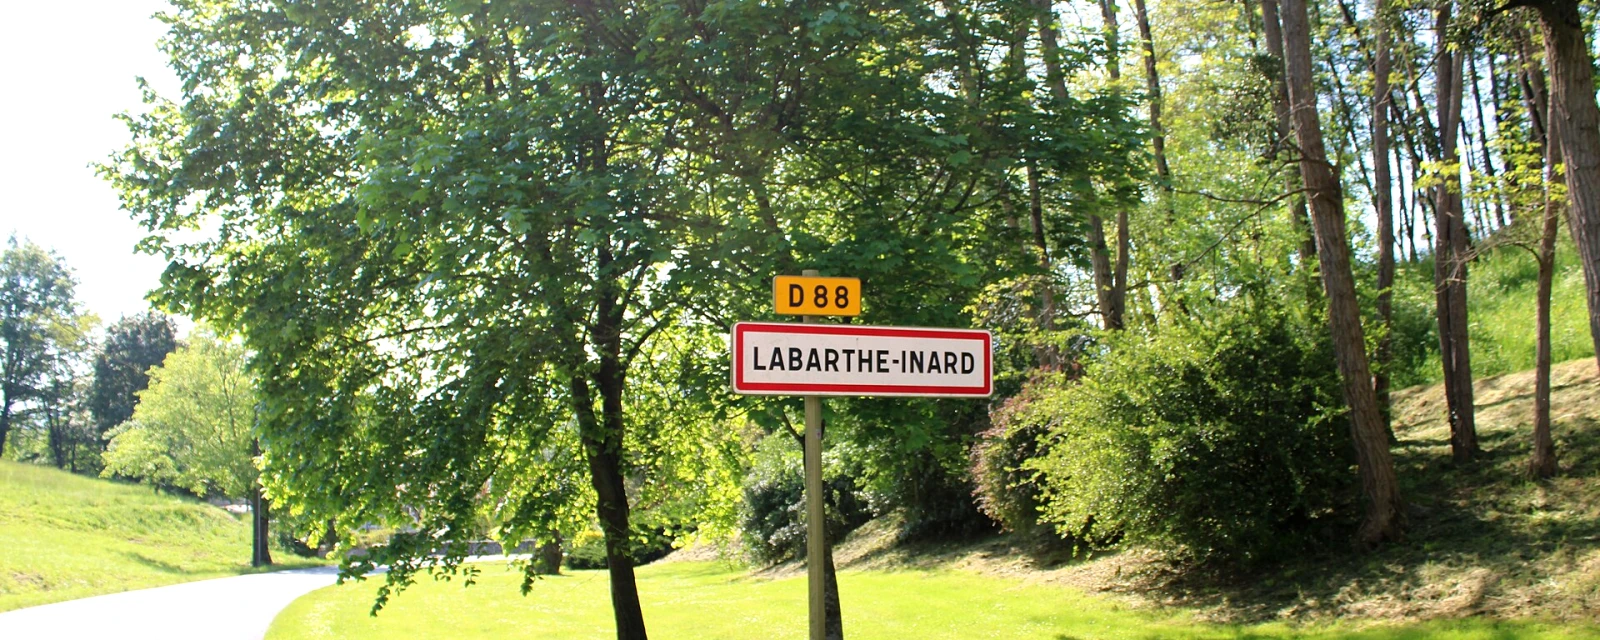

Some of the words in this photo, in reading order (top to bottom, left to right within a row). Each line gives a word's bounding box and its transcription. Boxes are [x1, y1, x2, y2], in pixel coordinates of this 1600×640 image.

[789, 284, 804, 308] D
[813, 285, 849, 309] 88
[753, 346, 975, 375] LABARTHE-INARD
